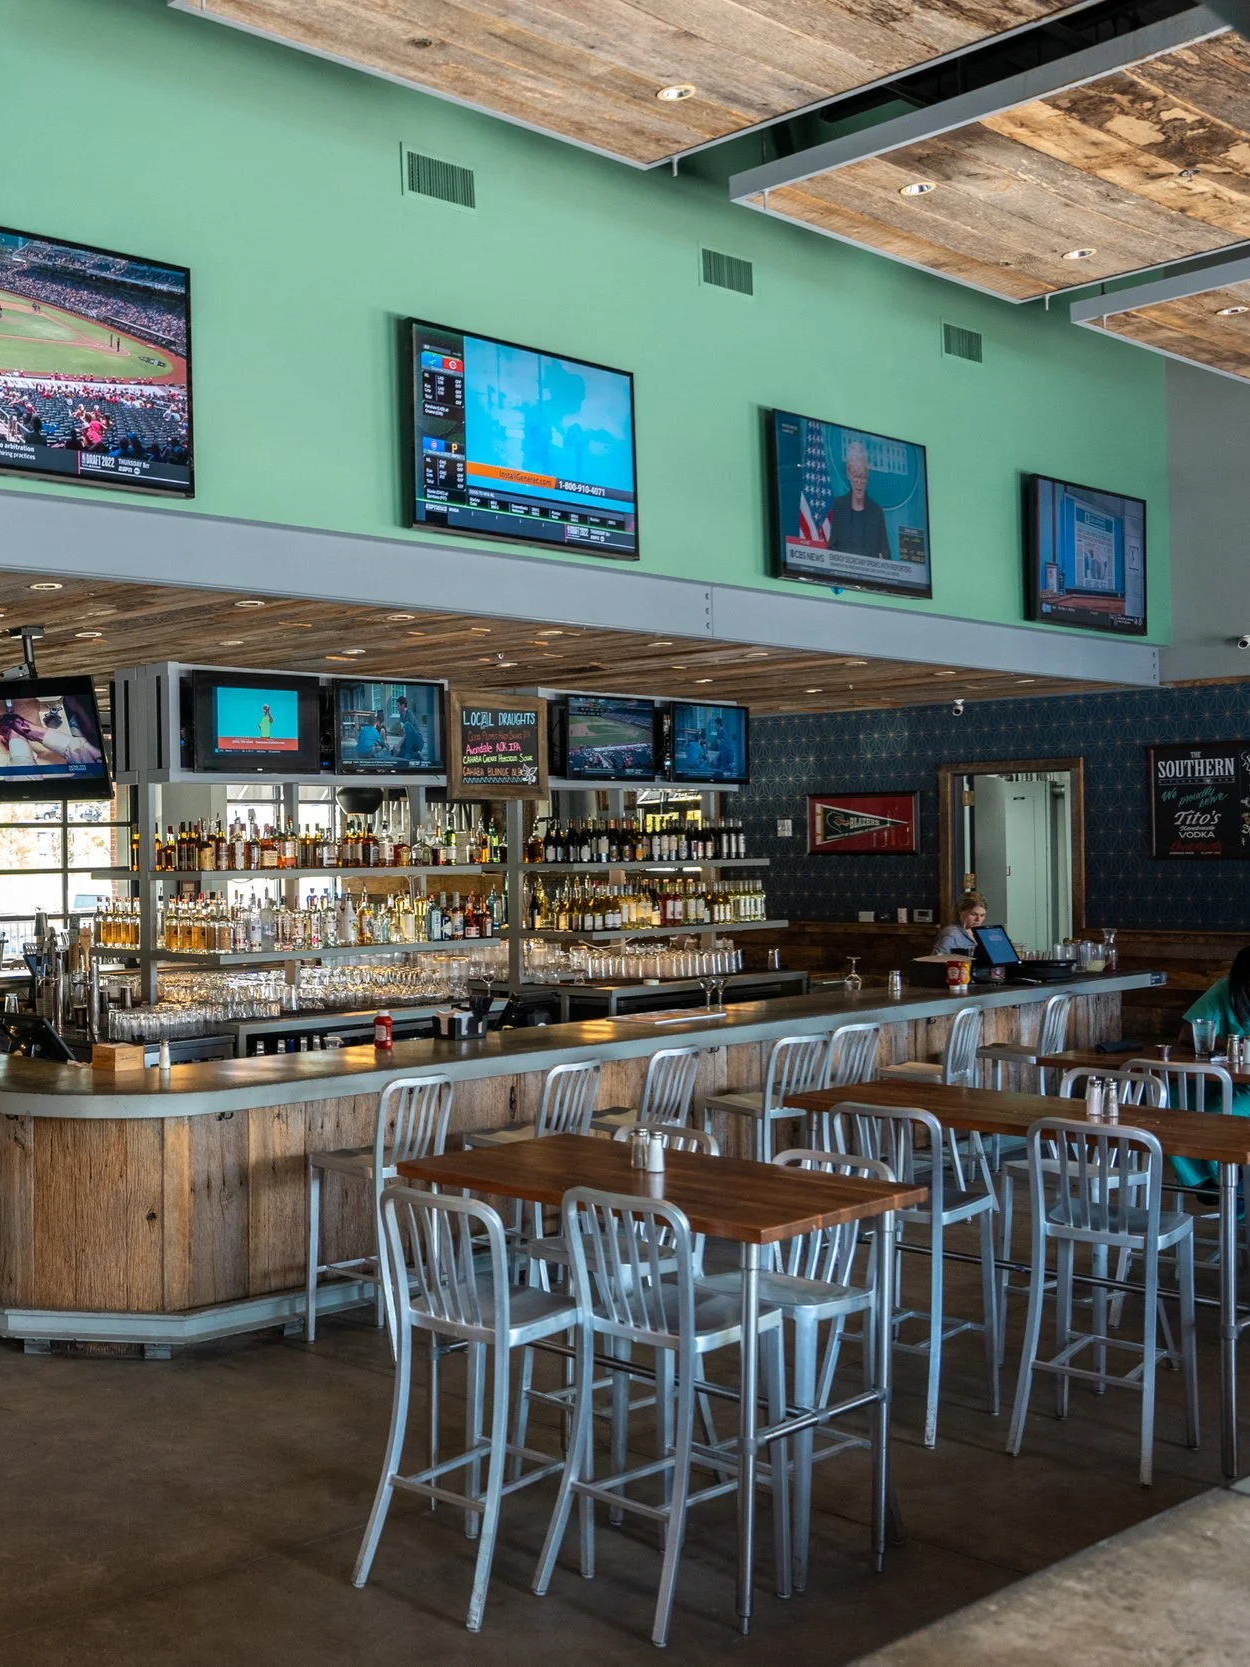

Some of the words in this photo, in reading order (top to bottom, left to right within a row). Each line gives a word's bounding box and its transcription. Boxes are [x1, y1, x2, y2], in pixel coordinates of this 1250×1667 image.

[4, 442, 35, 452] arbitration
[14, 452, 36, 460] practices
[86, 454, 101, 466] DRAFT
[102, 456, 115, 468] 2022
[559, 480, 606, 496] 1-800-910-4071
[794, 550, 806, 560] CBS
[806, 552, 824, 562] NEWS
[463, 711, 494, 729] LOCAL
[498, 712, 536, 726] DRAUGHTS
[466, 742, 492, 754] Avondale
[508, 742, 522, 752] IPA
[1158, 758, 1235, 778] SOUTHERN
[850, 817, 880, 829] BLAZERS
[1174, 810, 1222, 825] Tito's
